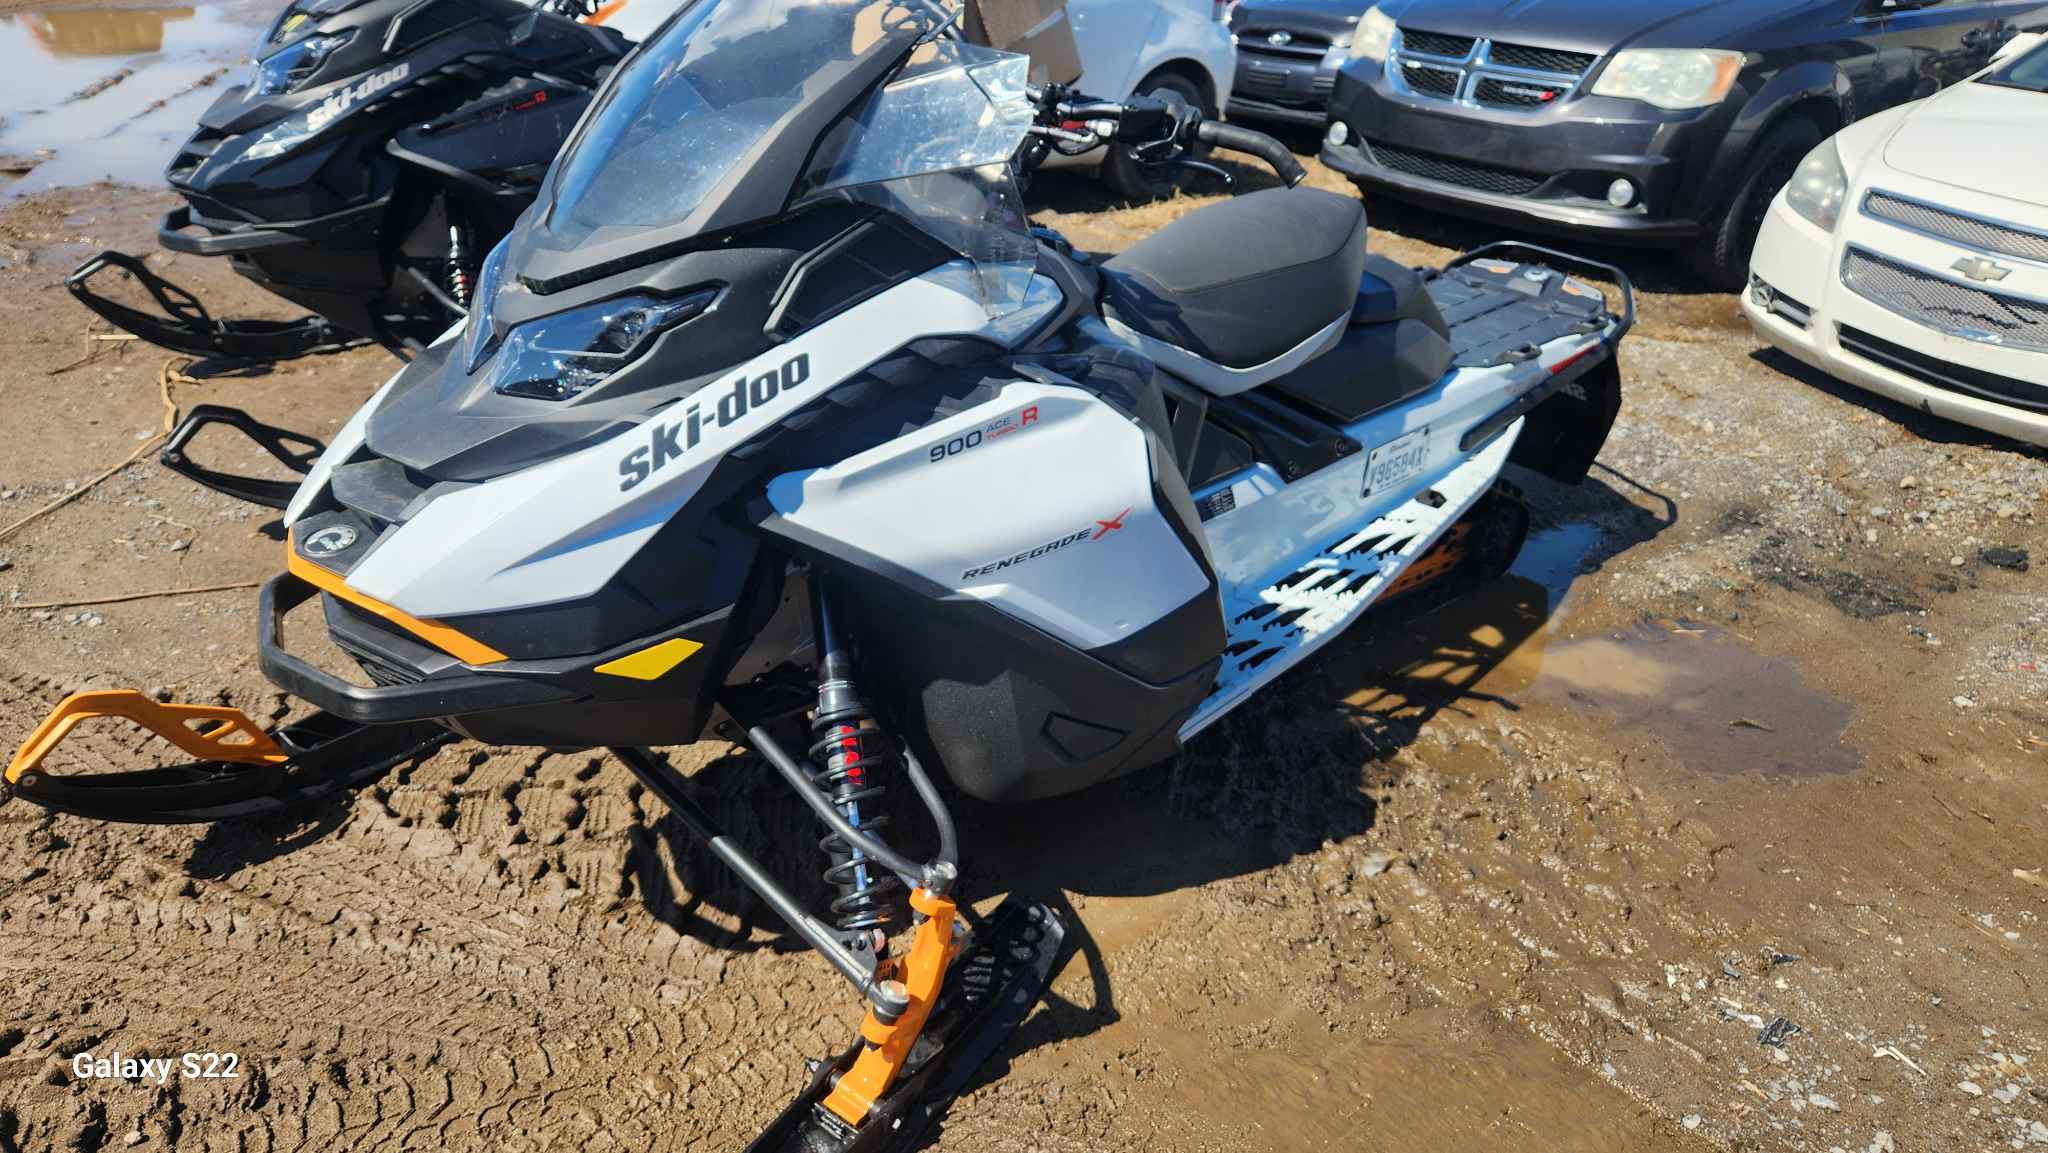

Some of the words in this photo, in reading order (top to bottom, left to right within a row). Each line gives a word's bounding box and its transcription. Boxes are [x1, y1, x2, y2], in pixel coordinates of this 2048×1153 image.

[930, 430, 982, 463] 900
[986, 416, 1012, 432] ACE
[1022, 406, 1038, 426] R
[961, 528, 1092, 580] RENEGADE
[1092, 507, 1132, 541] X
